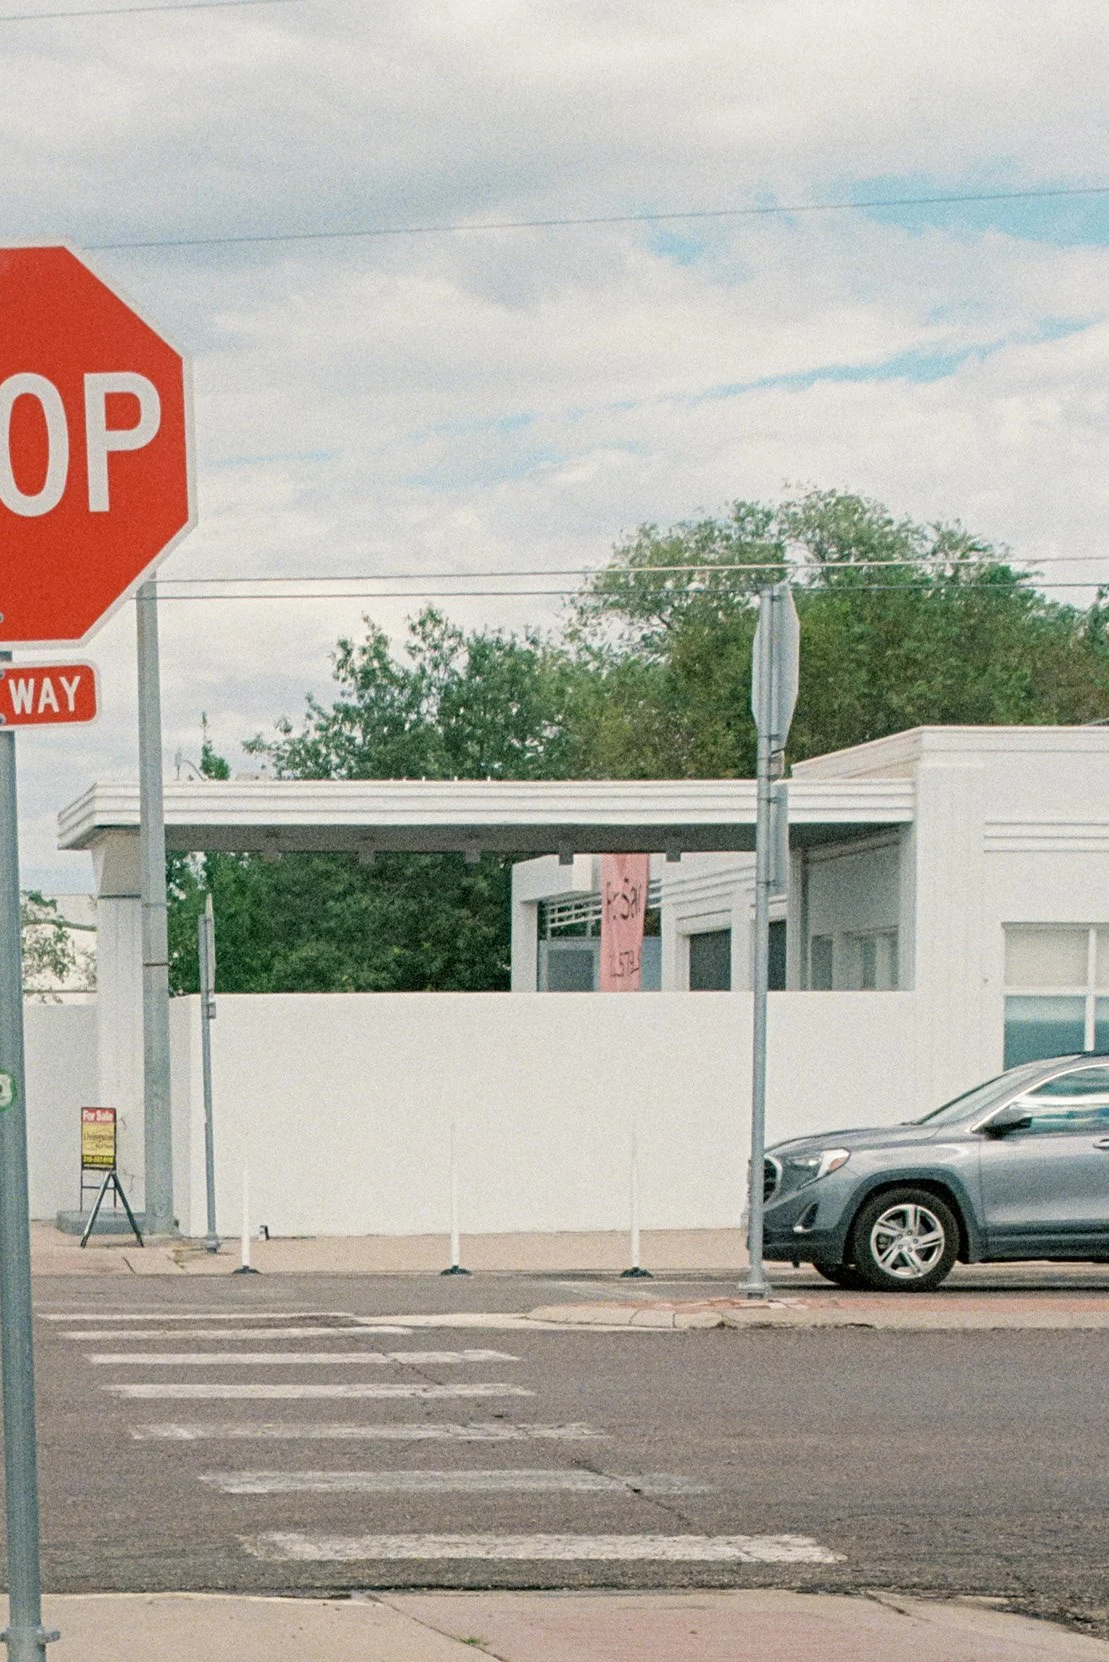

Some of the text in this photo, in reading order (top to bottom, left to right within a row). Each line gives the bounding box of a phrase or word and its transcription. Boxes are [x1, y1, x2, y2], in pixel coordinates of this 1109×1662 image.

[8, 675, 81, 715] WAY
[83, 1109, 114, 1122] For Sale
